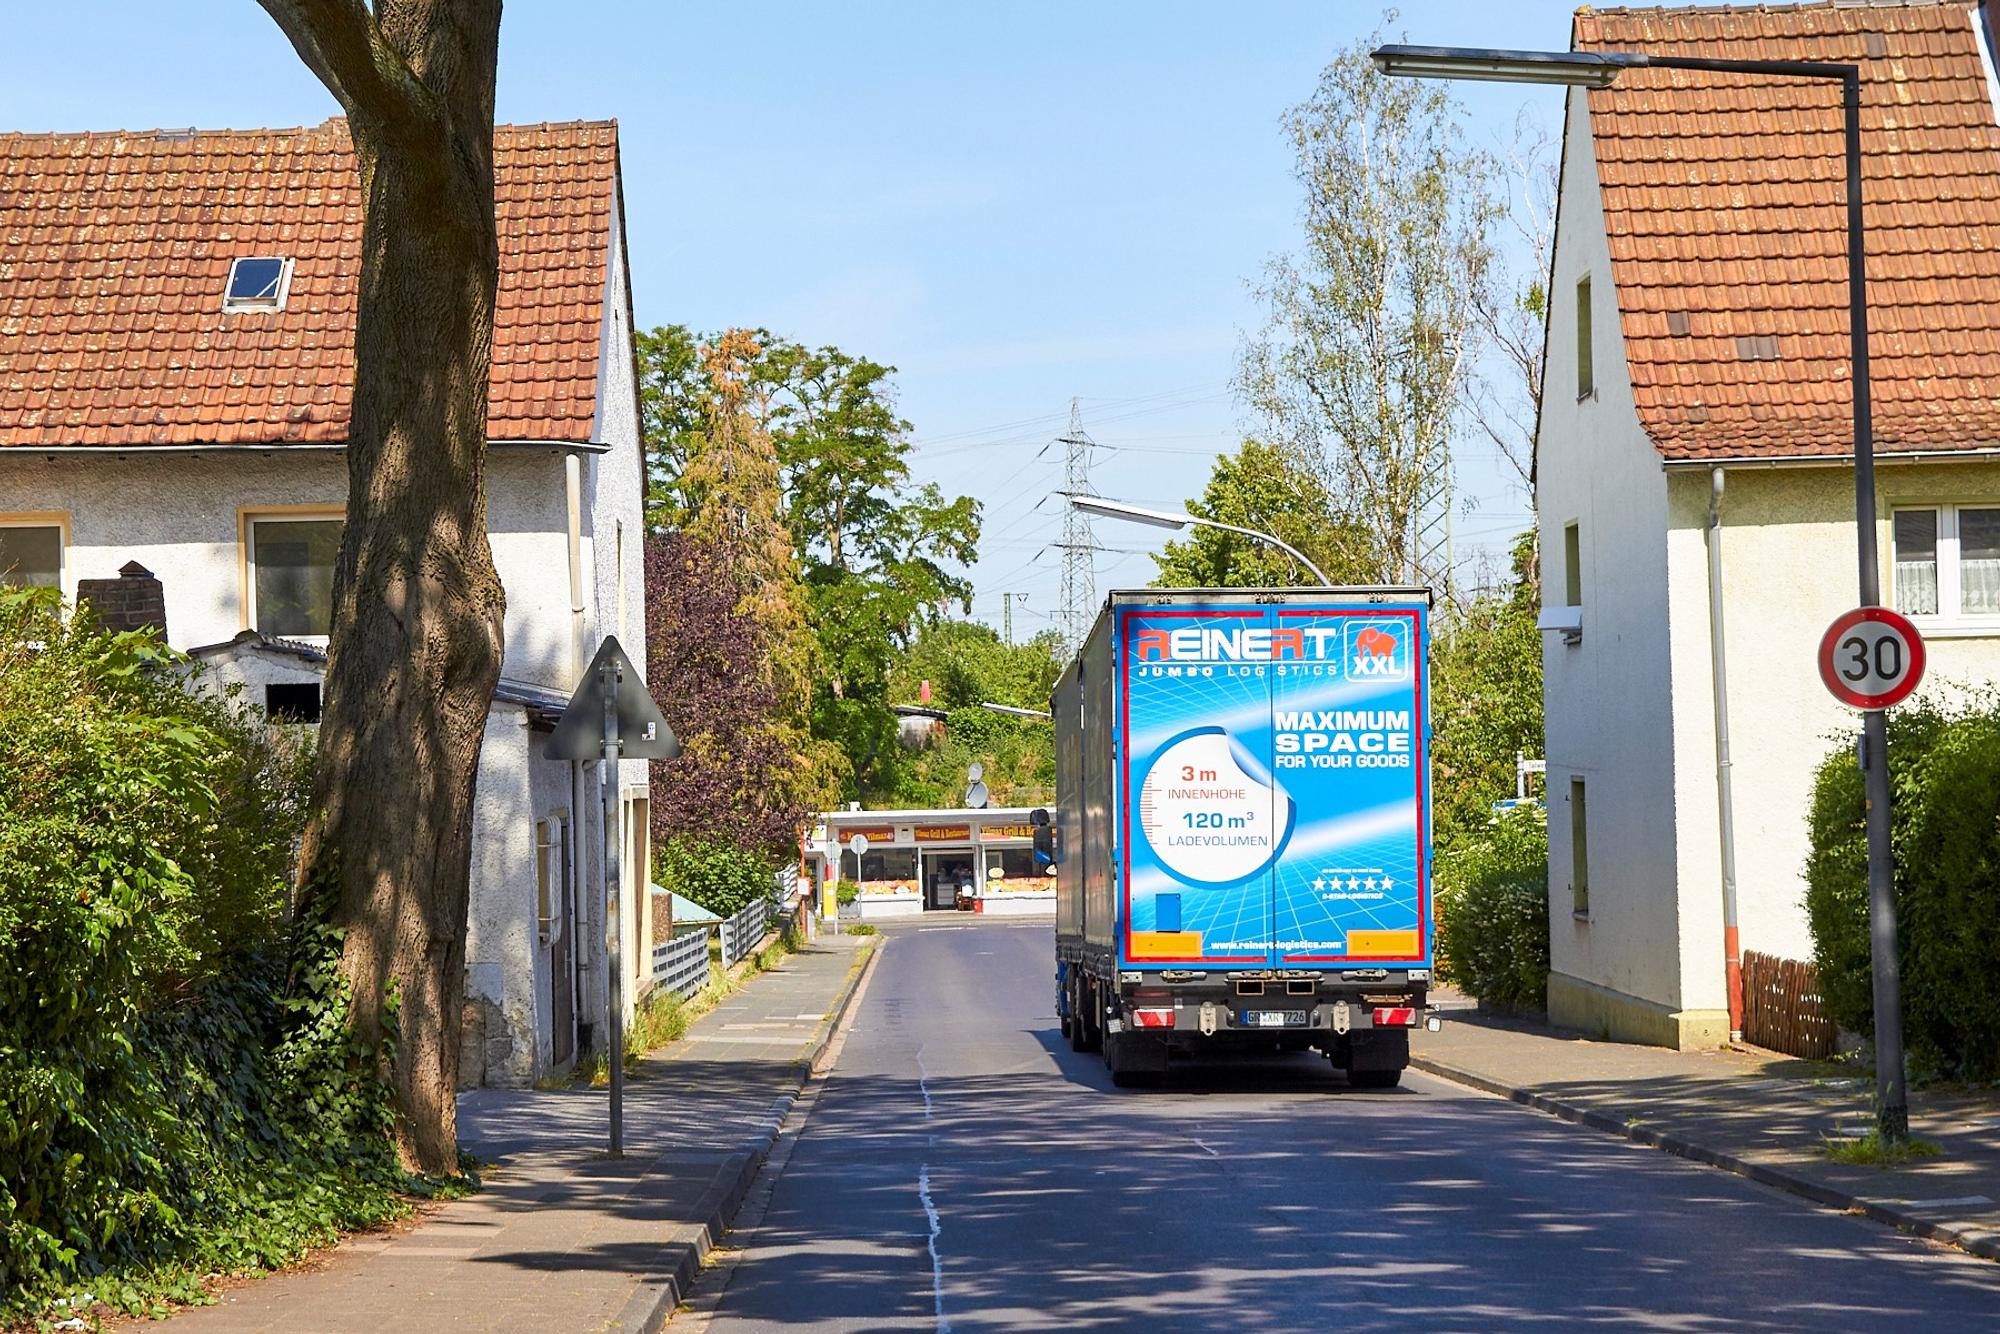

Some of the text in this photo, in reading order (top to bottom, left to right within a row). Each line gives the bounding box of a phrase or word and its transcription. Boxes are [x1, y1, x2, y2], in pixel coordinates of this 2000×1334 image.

[1138, 628, 1336, 660] REINERT
[1352, 655, 1403, 675] XXL
[1842, 635, 1901, 681] 30
[1138, 665, 1337, 677] JUMBO LOGSTICS
[1275, 711, 1409, 731] MAXIMUM
[1275, 732, 1410, 753] SPACE
[1275, 754, 1410, 769] FOR YOUR GOODS
[1181, 765, 1217, 782] 3 m
[1182, 812, 1224, 829] 120
[1168, 835, 1268, 846] LADEVOLUMEN
